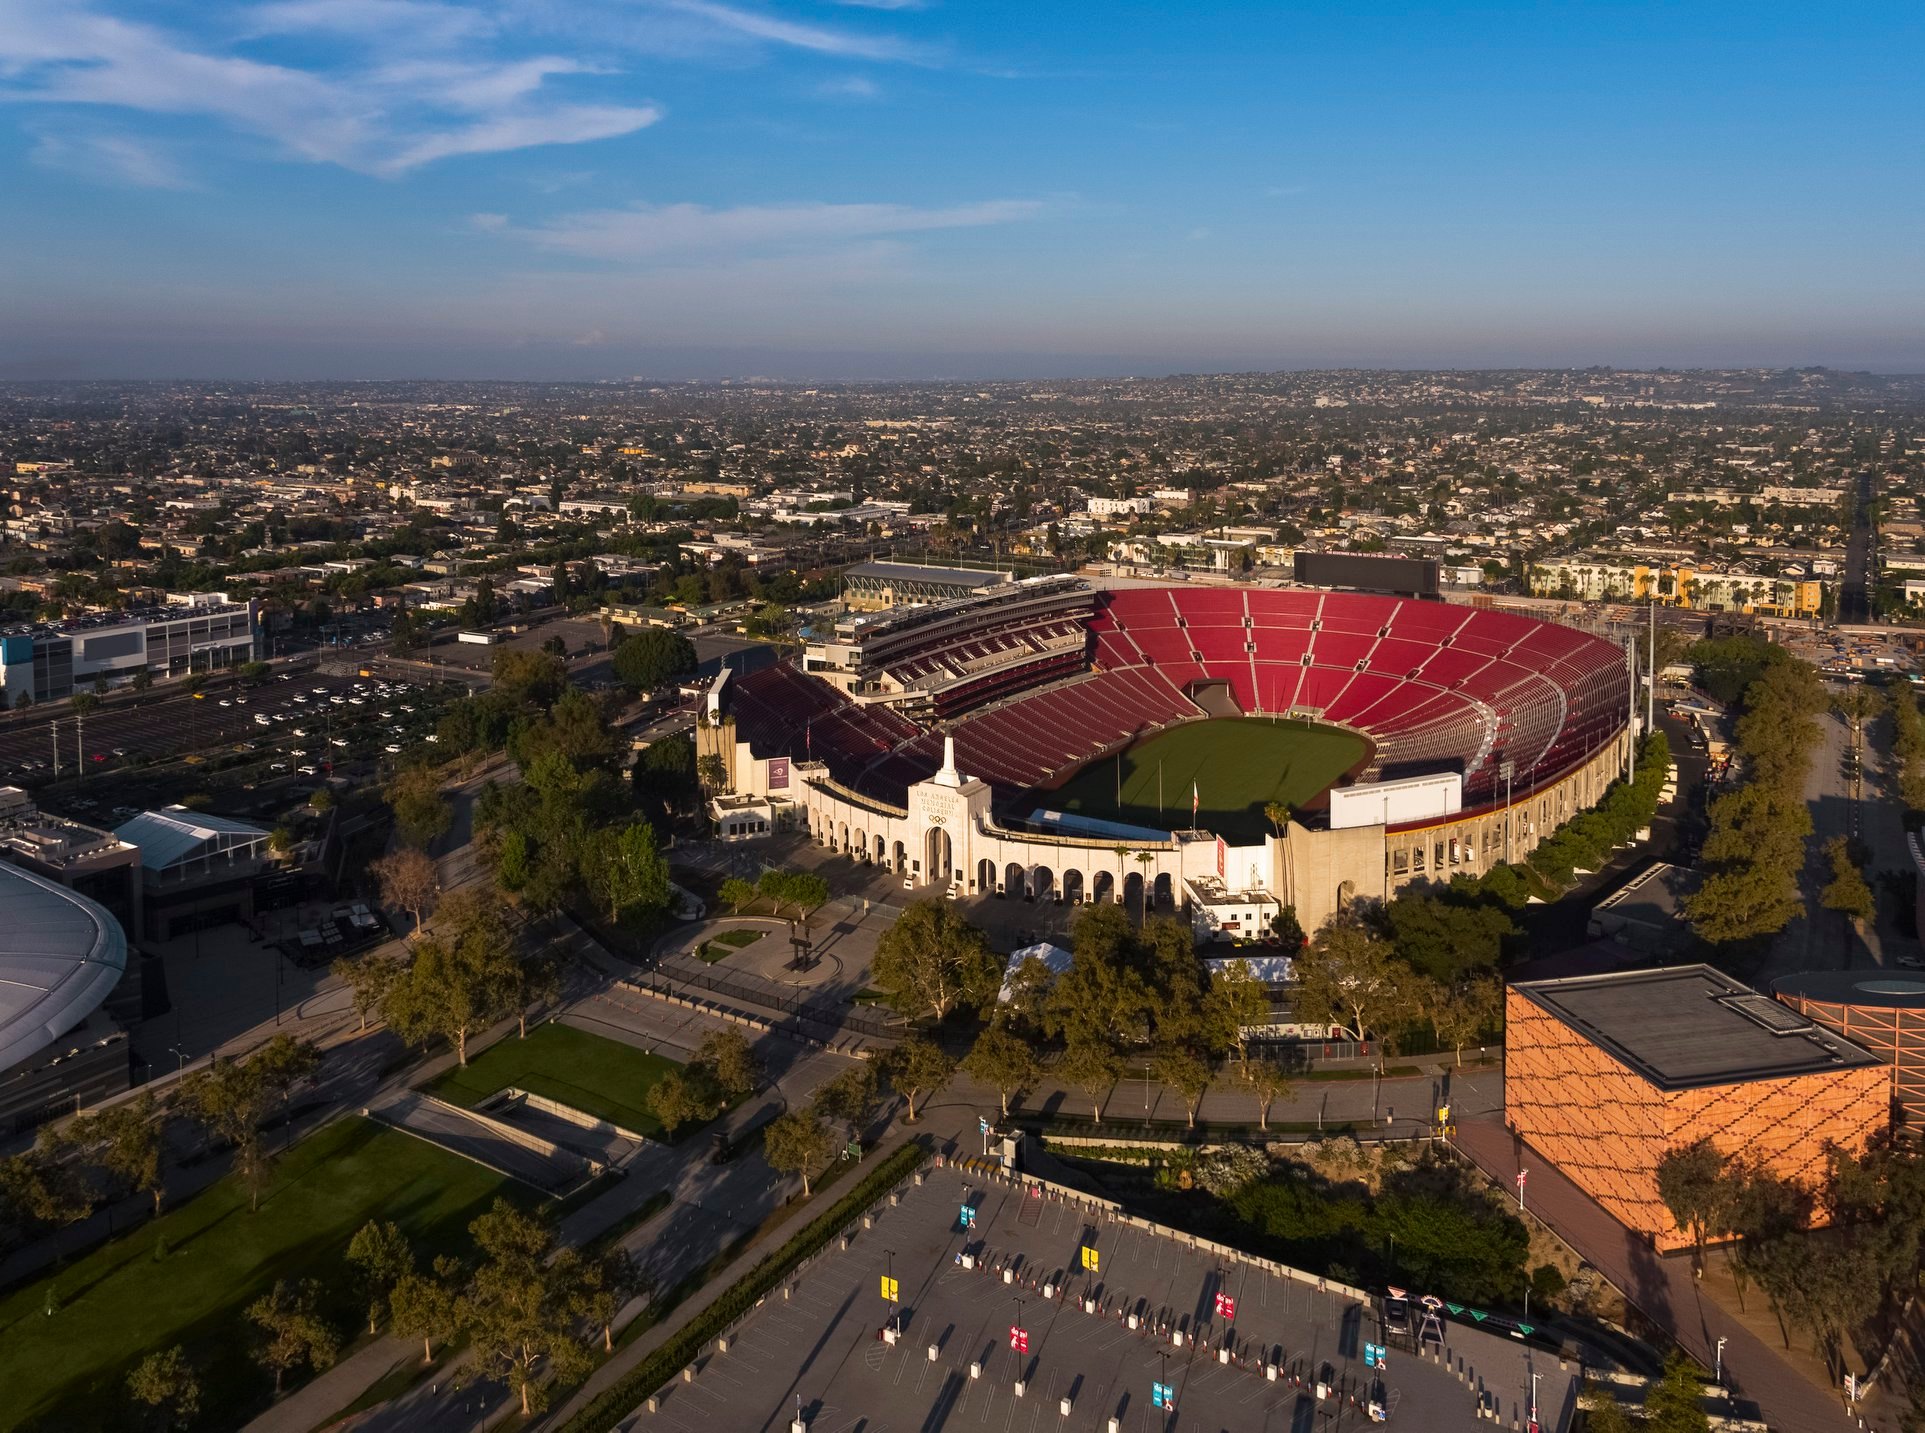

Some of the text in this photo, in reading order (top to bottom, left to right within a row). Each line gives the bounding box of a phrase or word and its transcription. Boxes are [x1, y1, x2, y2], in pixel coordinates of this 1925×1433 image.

[931, 793, 959, 803] ANGELES
[921, 798, 955, 810] MEMORIAL
[922, 805, 954, 816] COLISEUM
